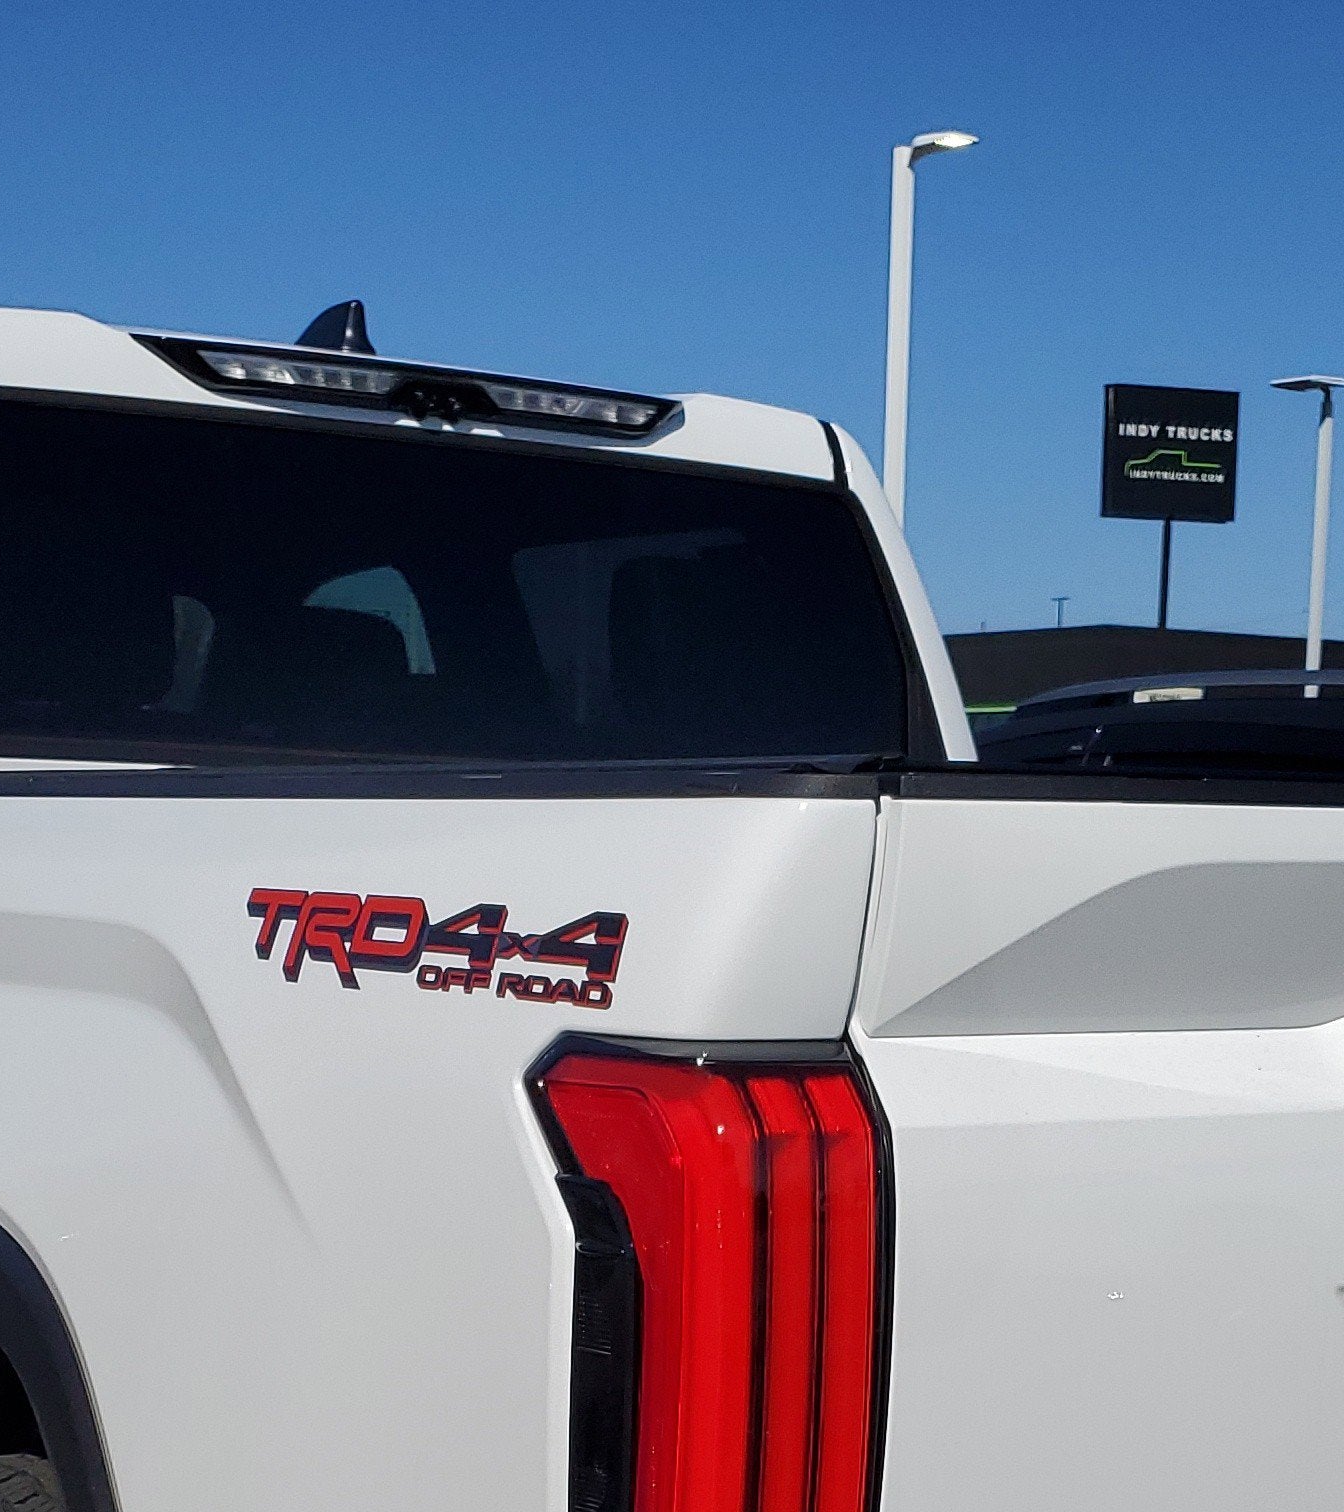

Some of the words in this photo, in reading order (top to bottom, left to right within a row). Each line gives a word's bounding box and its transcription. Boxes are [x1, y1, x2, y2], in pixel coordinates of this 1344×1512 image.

[1118, 423, 1160, 437] INDY
[1166, 425, 1233, 442] TRUCKS
[247, 887, 430, 990] TRD
[416, 965, 492, 995] OFF
[495, 972, 613, 1010] ROAD
